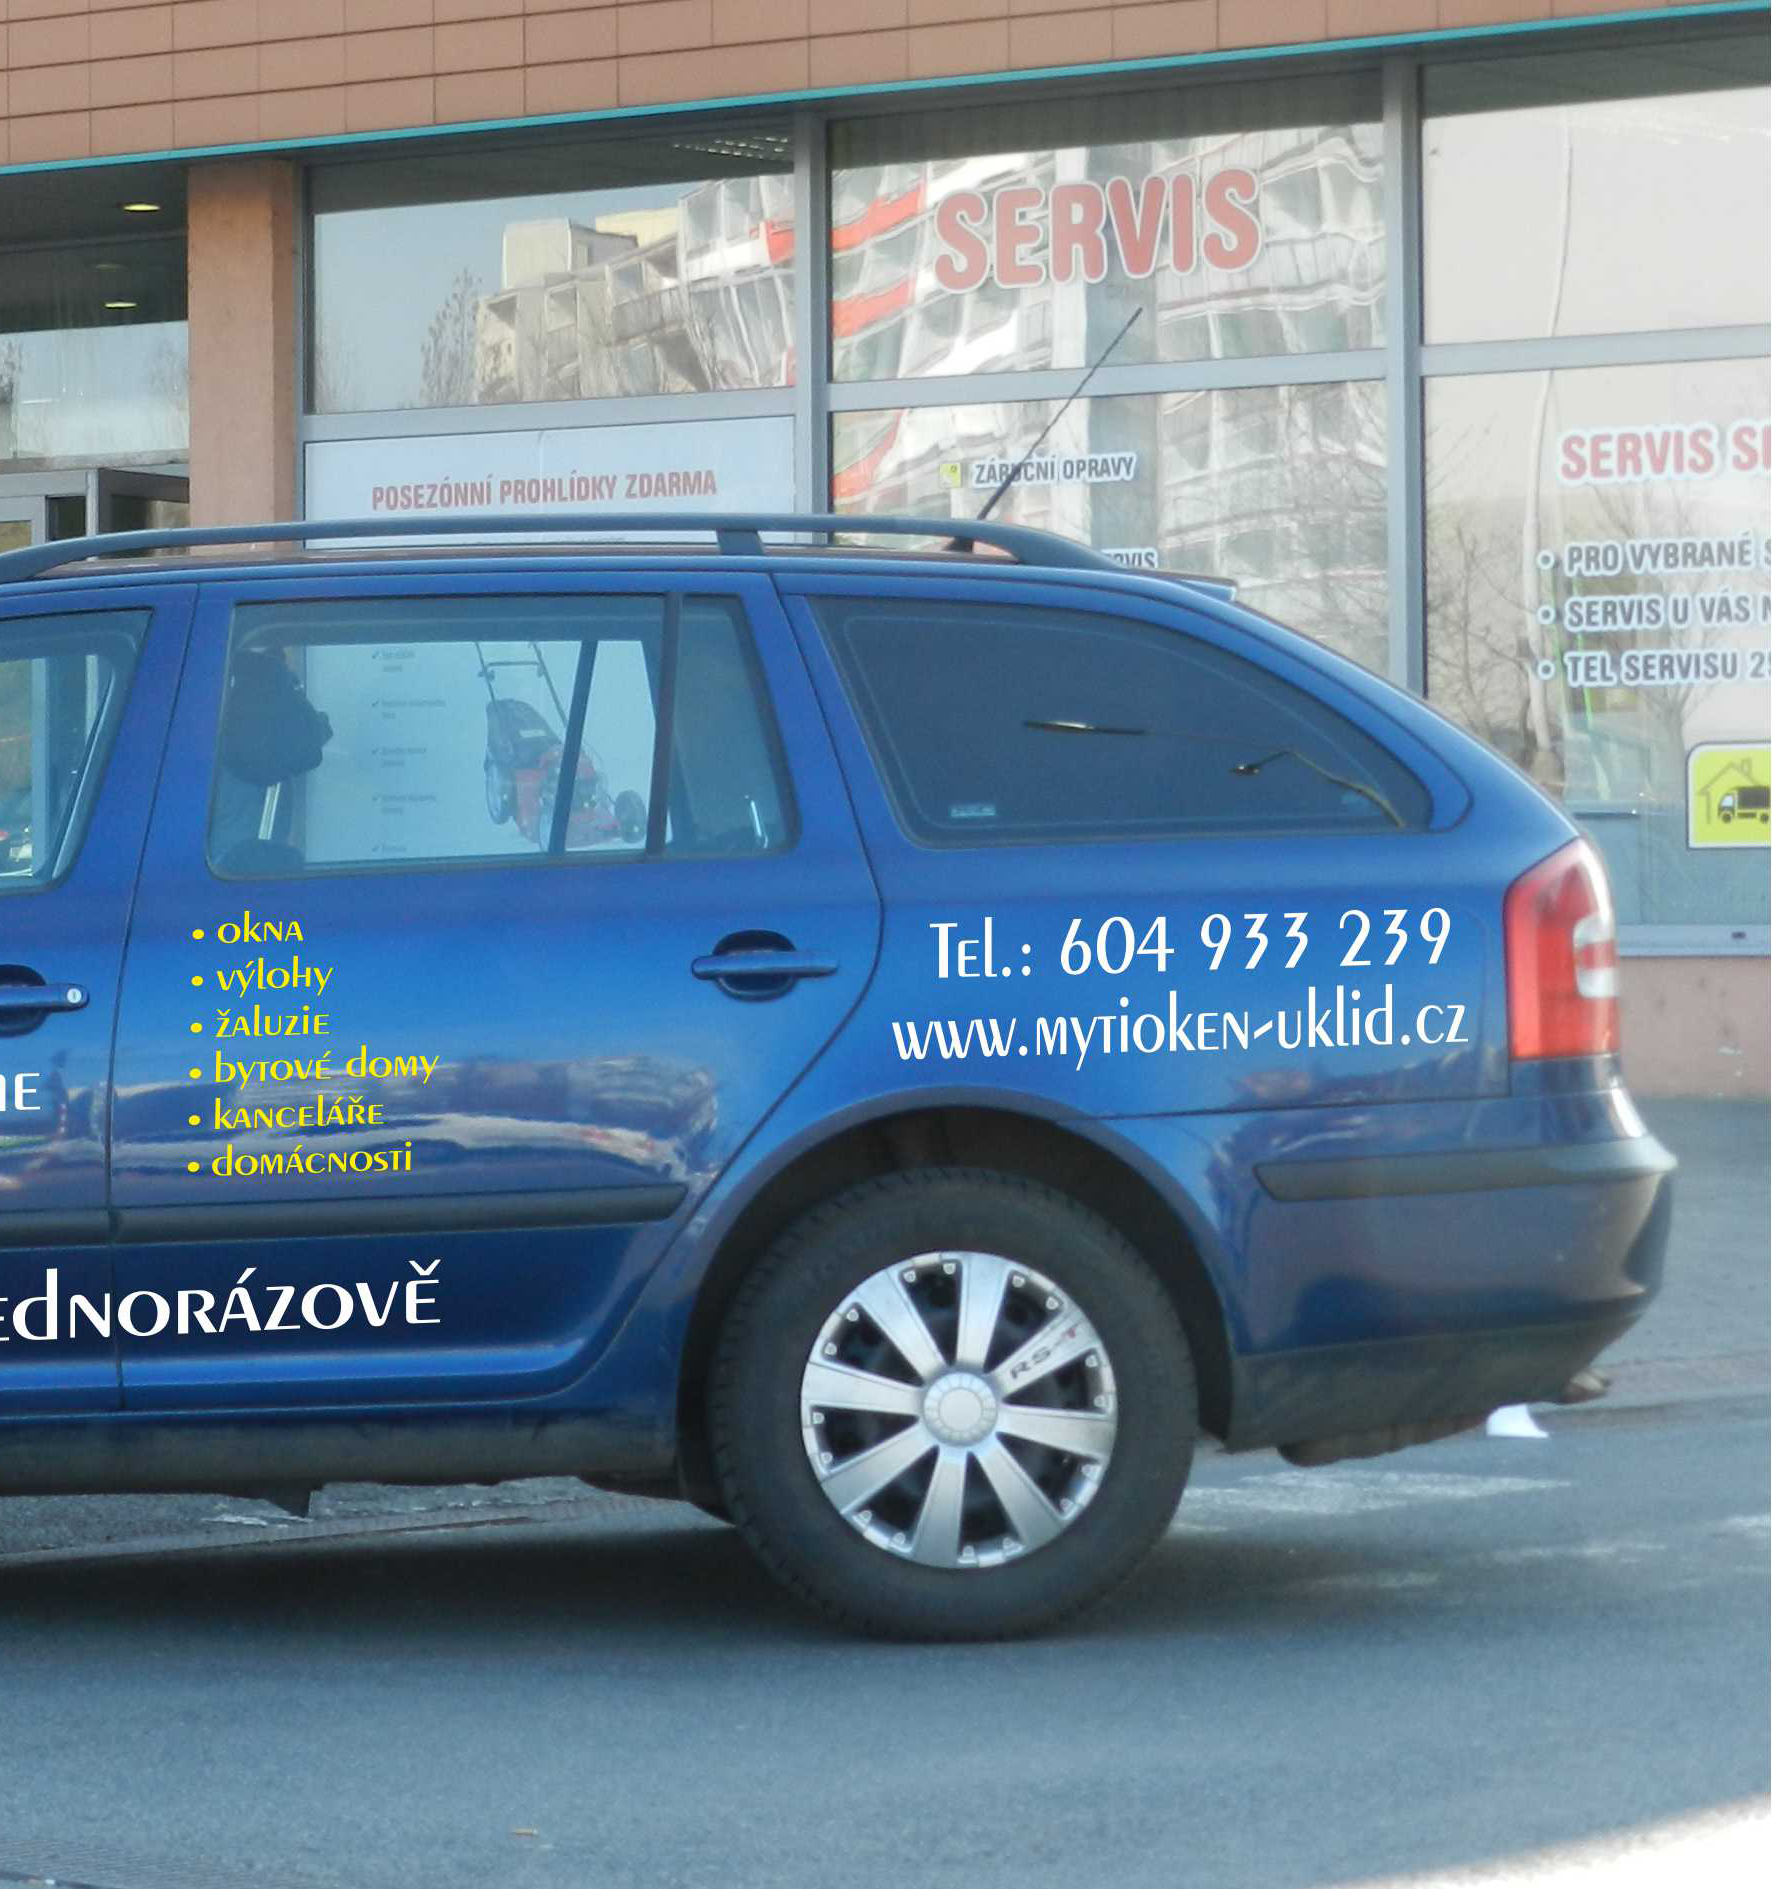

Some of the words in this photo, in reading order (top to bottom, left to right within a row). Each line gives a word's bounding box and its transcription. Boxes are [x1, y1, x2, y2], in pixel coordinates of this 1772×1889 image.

[935, 168, 1260, 293] SERVIS
[1063, 455, 1134, 480] OPRAVY
[1561, 427, 1714, 480] SERVIS
[372, 473, 493, 511] POSEZÓNNÍ
[499, 470, 618, 505] PROHLÍDKY
[625, 469, 718, 499] ZDARMA
[1567, 544, 1620, 573] PRO
[1629, 531, 1753, 570] VYBRANÉ
[1567, 597, 1662, 627] SERVIS
[1672, 597, 1689, 625] U
[1699, 587, 1750, 623] VÁS
[1567, 655, 1614, 683] TEL
[1625, 652, 1738, 682] SERVISU
[1749, 650, 1771, 679] 2
[217, 911, 304, 943] okna
[929, 916, 1032, 978] Tel.:
[1060, 916, 1174, 975] 604
[1200, 913, 1309, 970] 933
[1339, 907, 1452, 967] 239
[216, 955, 333, 998] výlohy
[215, 1004, 330, 1037] žaluzie
[891, 983, 1469, 1071] www.mytioken-uklid.cz
[215, 1050, 332, 1090] bytové
[346, 1044, 440, 1084] domy
[214, 1094, 384, 1130] kanceláře
[211, 1141, 412, 1176] domácnosti
